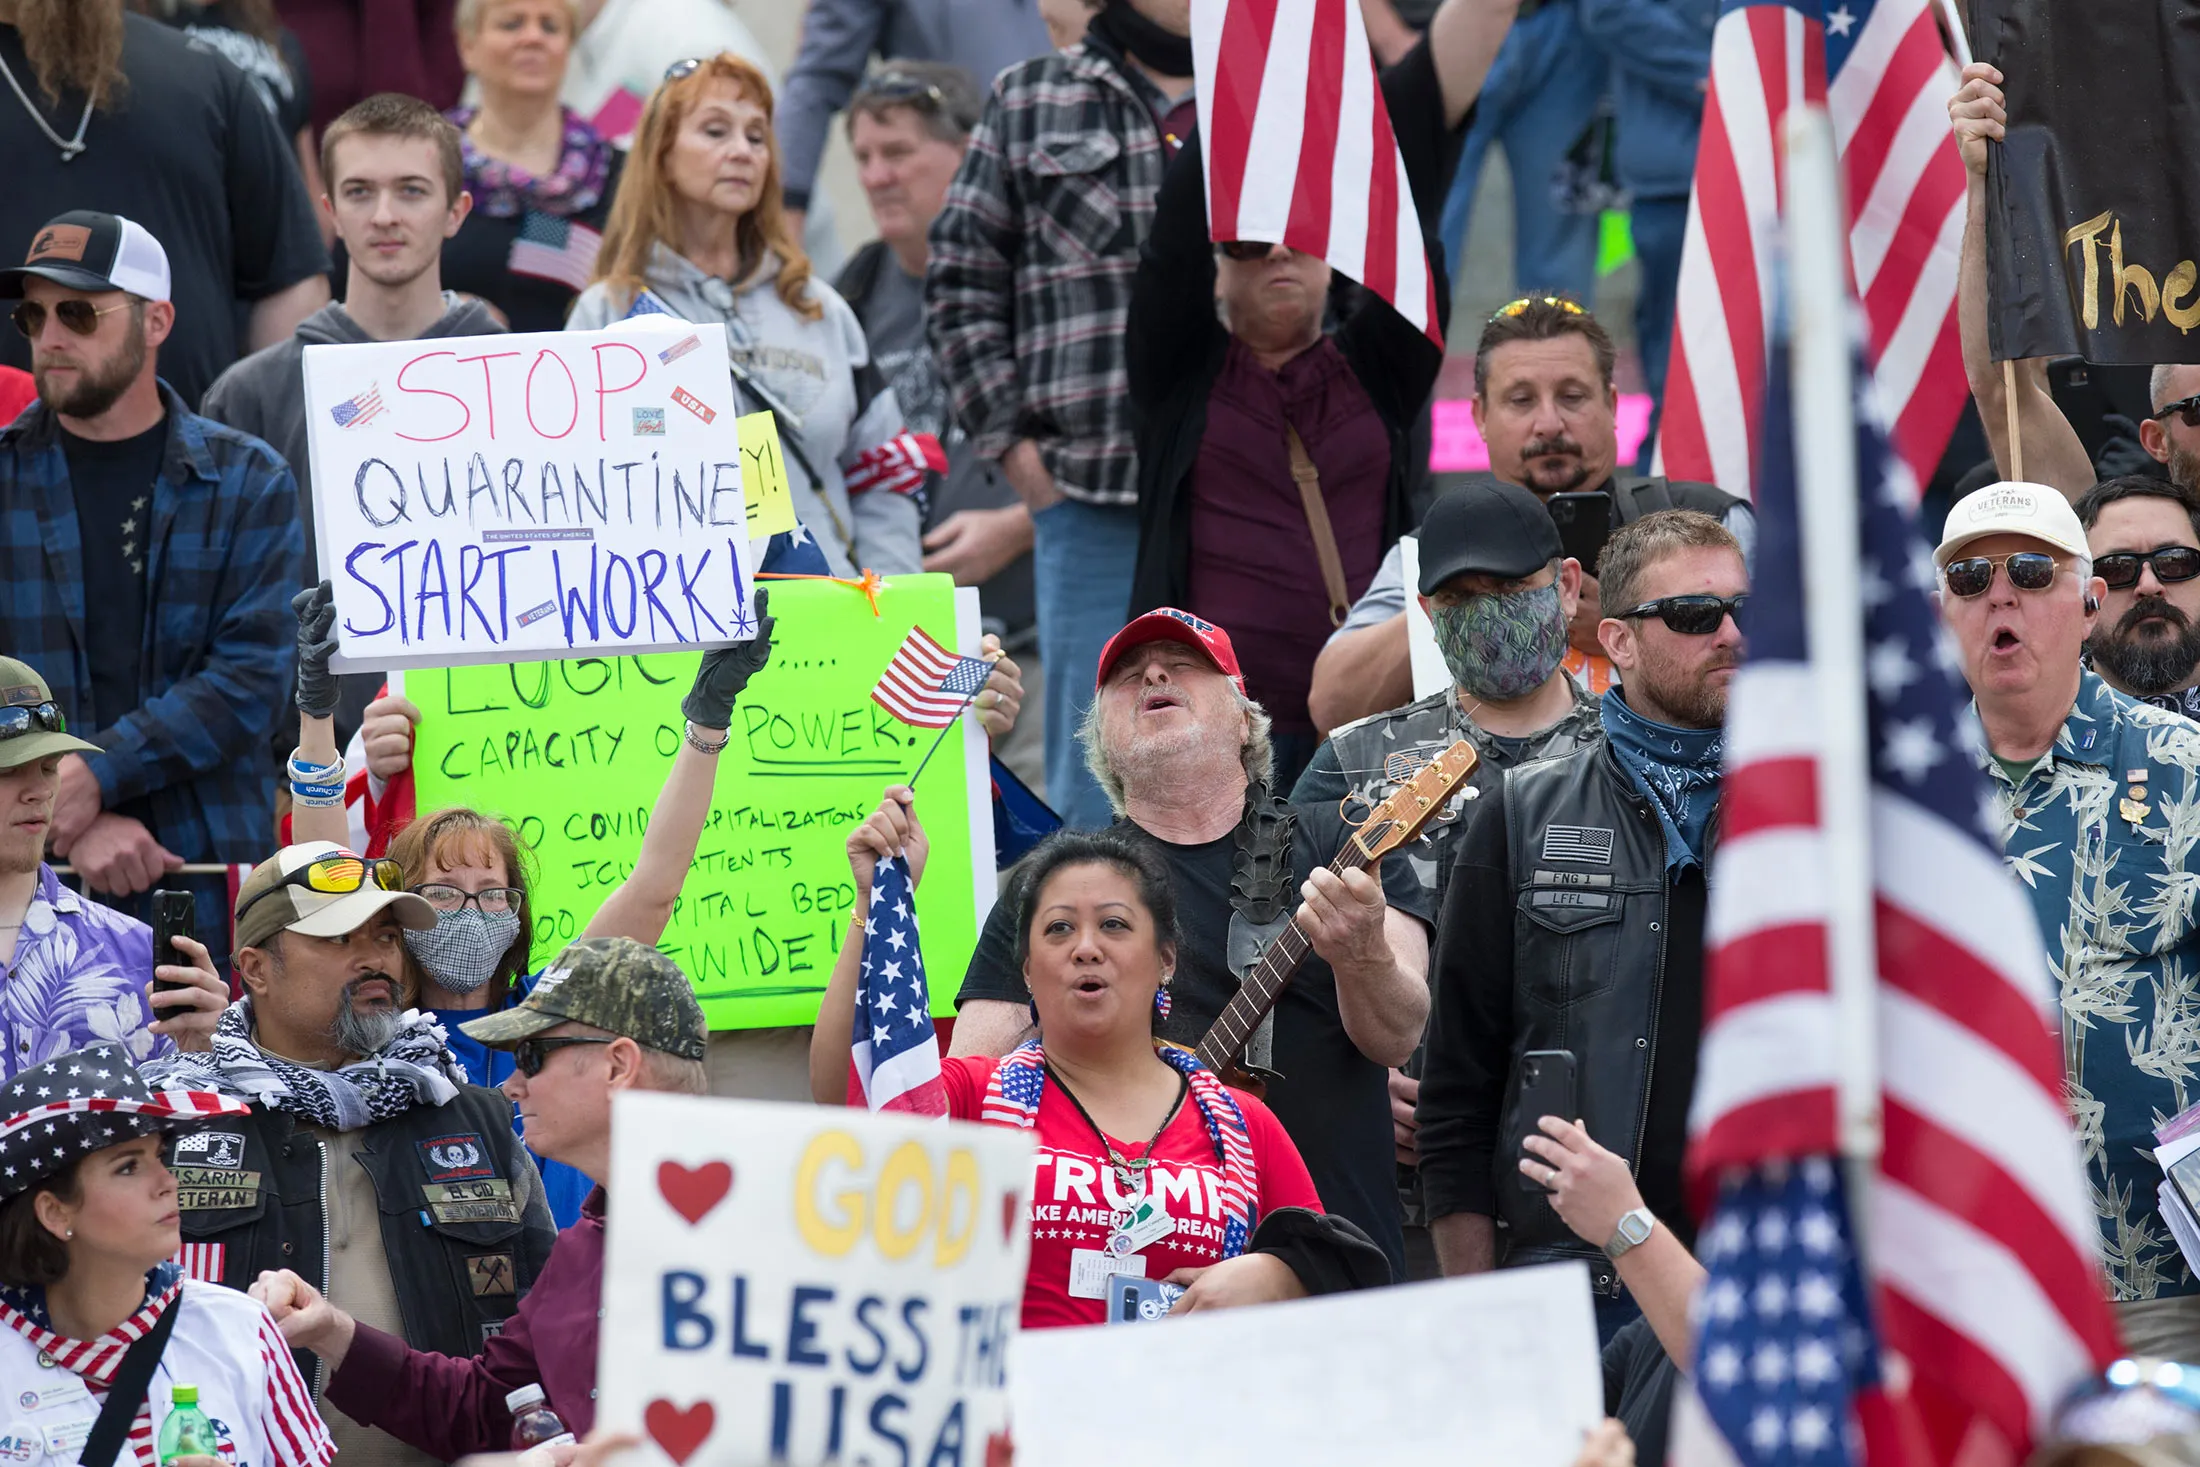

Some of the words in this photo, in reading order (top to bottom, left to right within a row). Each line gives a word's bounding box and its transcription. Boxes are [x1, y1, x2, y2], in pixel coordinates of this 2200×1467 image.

[2064, 209, 2200, 335] The
[395, 342, 647, 442] STOP
[680, 393, 706, 418] USA
[344, 538, 531, 647] START
[440, 723, 625, 779] CAPACITY
[305, 786, 334, 796] Church
[305, 799, 334, 807] Church
[563, 806, 649, 841] COVID
[704, 802, 865, 833] PITALIZATIONS
[1553, 873, 1579, 884] FNG
[1584, 875, 1591, 884] 1
[672, 890, 768, 928] PITAL
[1552, 892, 1584, 905] LFFL
[177, 1191, 248, 1207] ETERAN
[448, 1185, 469, 1199] EL
[471, 1182, 494, 1199] CID
[794, 1129, 980, 1269] GOD
[1027, 1204, 1061, 1222] AKE
[661, 1267, 931, 1384] BLESS
